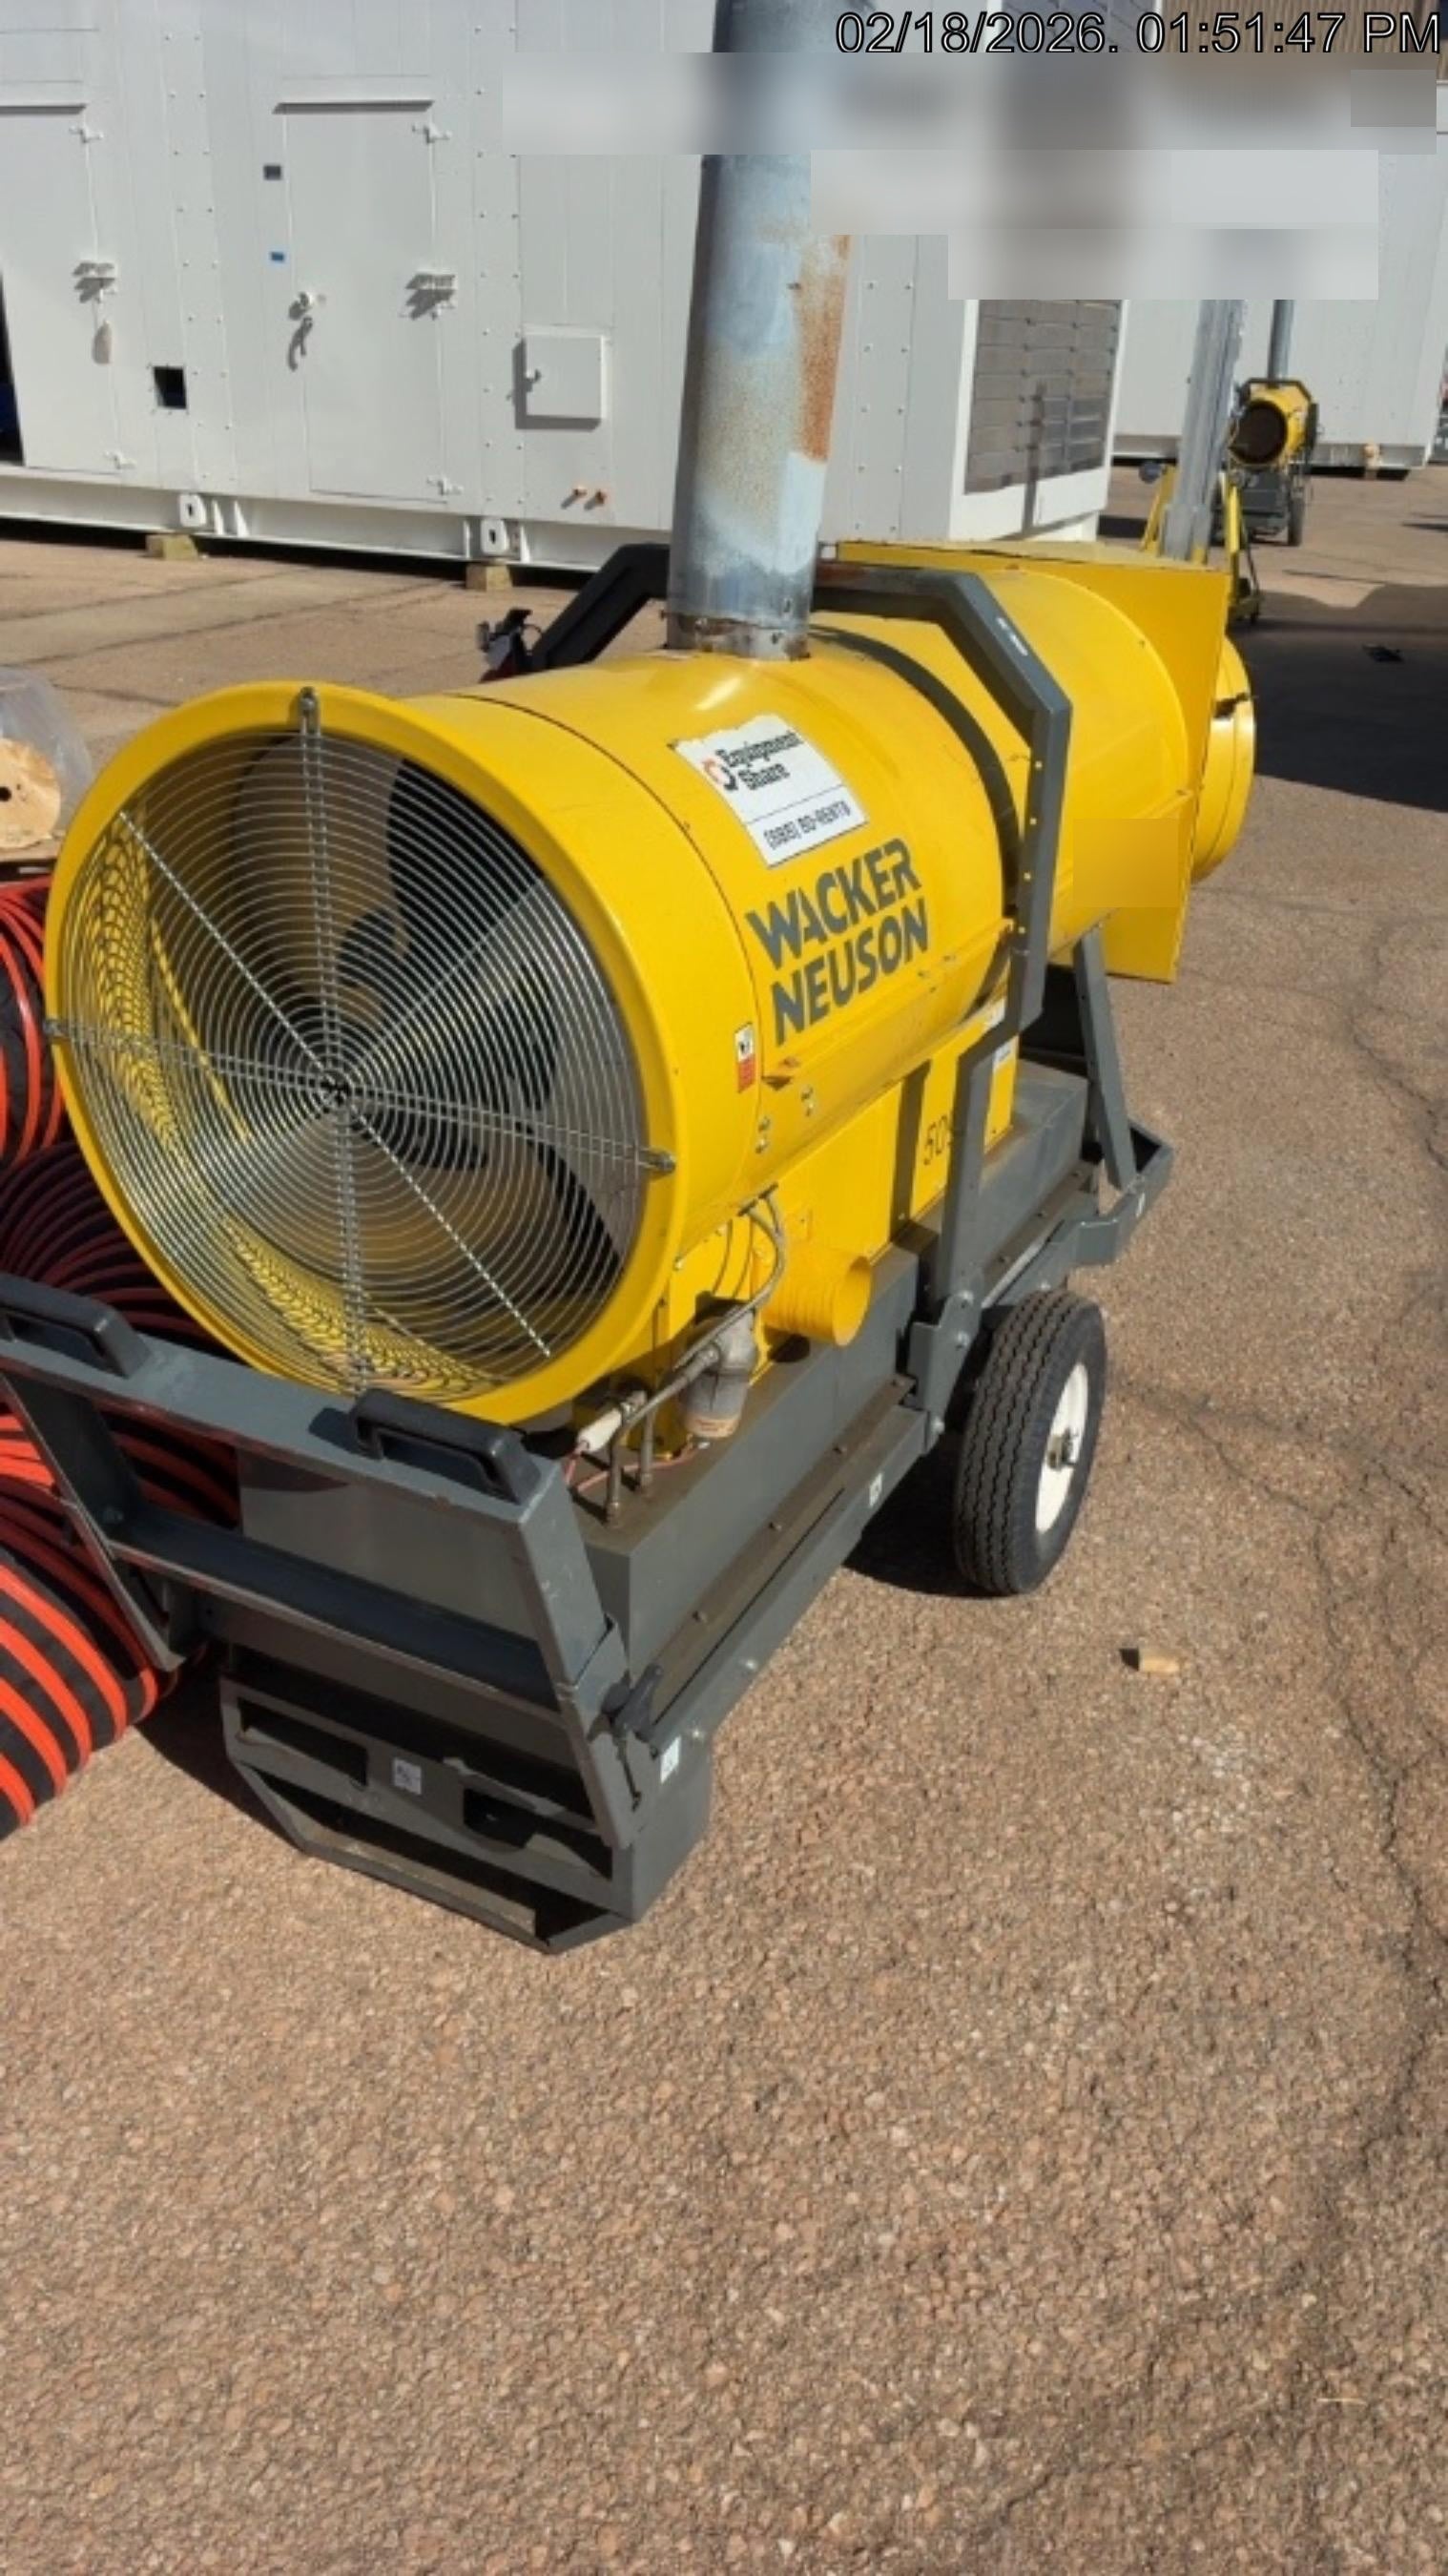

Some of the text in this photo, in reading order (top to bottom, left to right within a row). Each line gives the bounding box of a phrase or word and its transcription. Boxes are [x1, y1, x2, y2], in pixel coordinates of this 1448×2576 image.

[715, 730, 804, 767] Equipment
[737, 763, 791, 791] Share
[745, 837, 922, 971] WACKER
[771, 897, 929, 1048] NEUSON
[922, 1112, 953, 1167] 50
